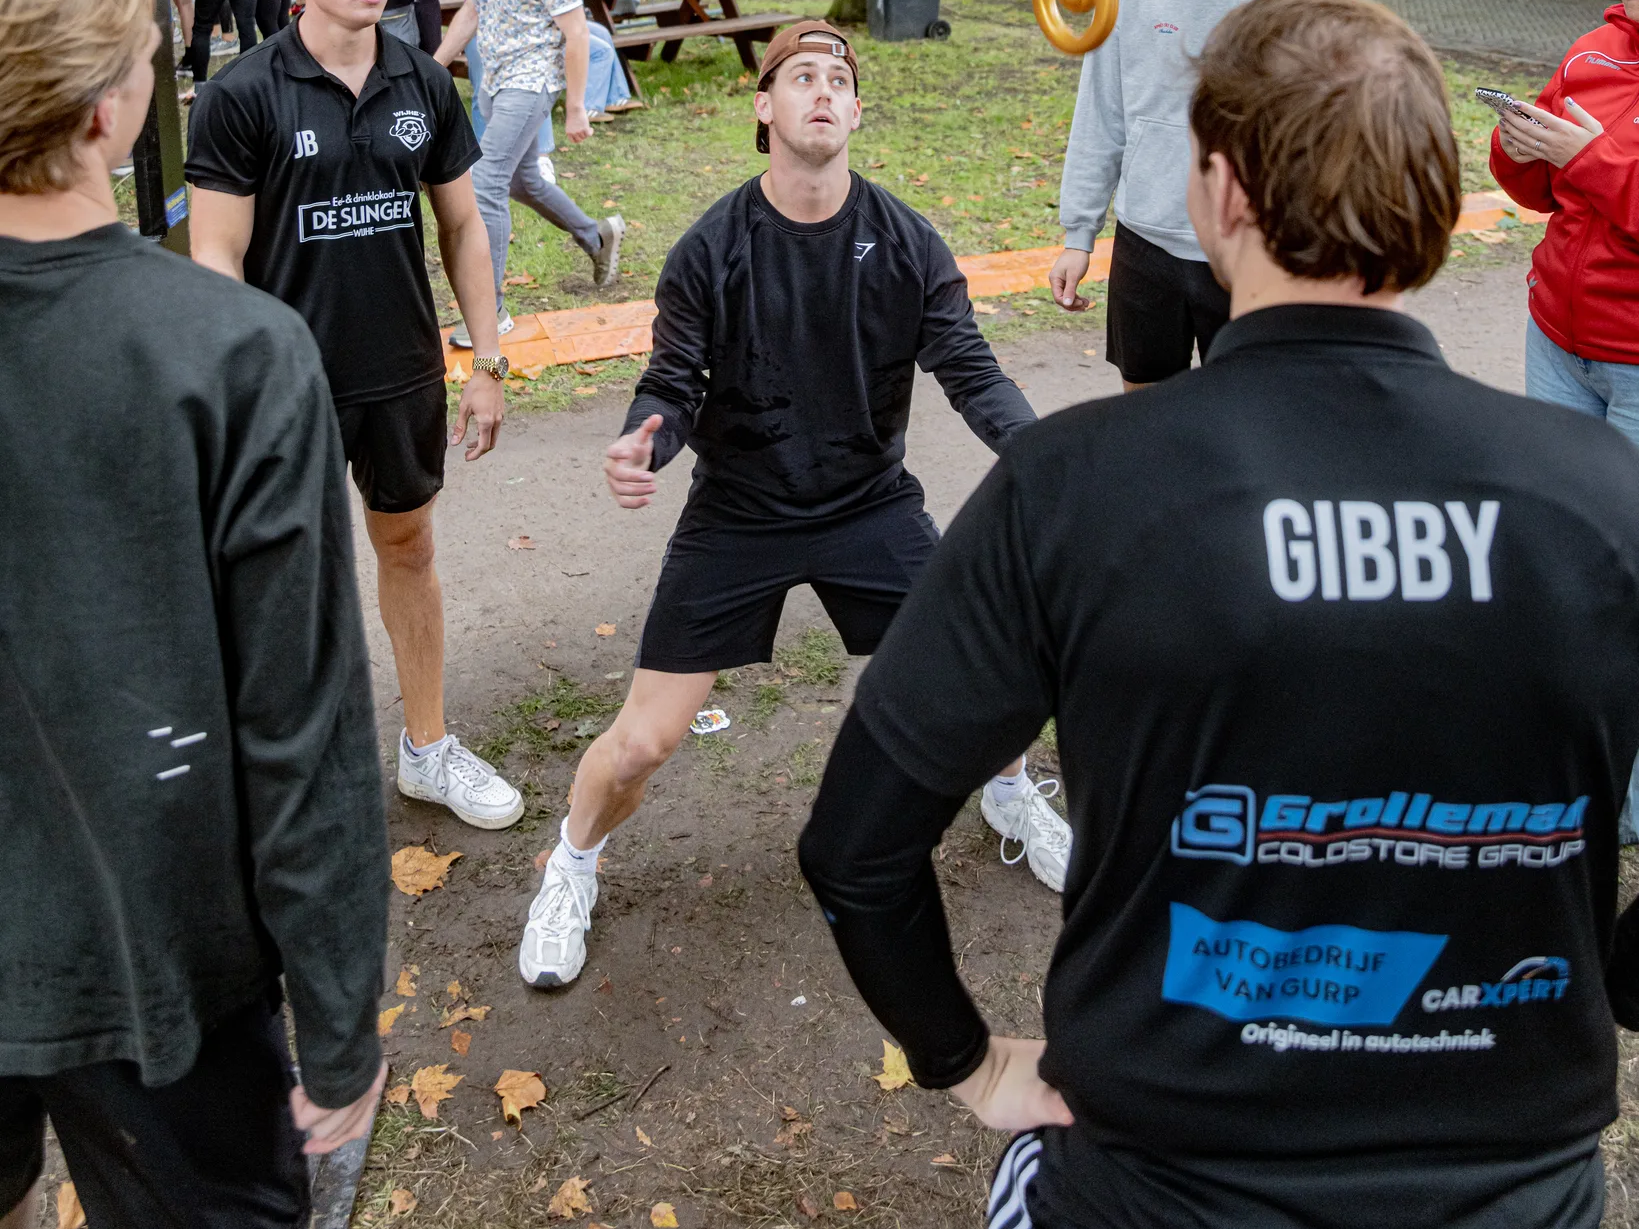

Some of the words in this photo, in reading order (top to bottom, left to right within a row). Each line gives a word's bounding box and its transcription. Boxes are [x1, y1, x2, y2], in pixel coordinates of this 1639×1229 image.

[294, 129, 319, 159] JB
[353, 189, 395, 203] drinklokaal
[312, 210, 338, 230] DE
[1263, 498, 1500, 602] GIBBY
[1257, 837, 1470, 869] COLDSTORE
[1478, 838, 1586, 869] GROUP
[1193, 937, 1388, 974] AUTOBEDRIJF
[1214, 967, 1273, 1003] VAN
[1280, 976, 1361, 1006] GURP
[1241, 1022, 1340, 1053] Origineel
[1341, 1029, 1362, 1051] in
[1363, 1027, 1497, 1053] autotechniek
